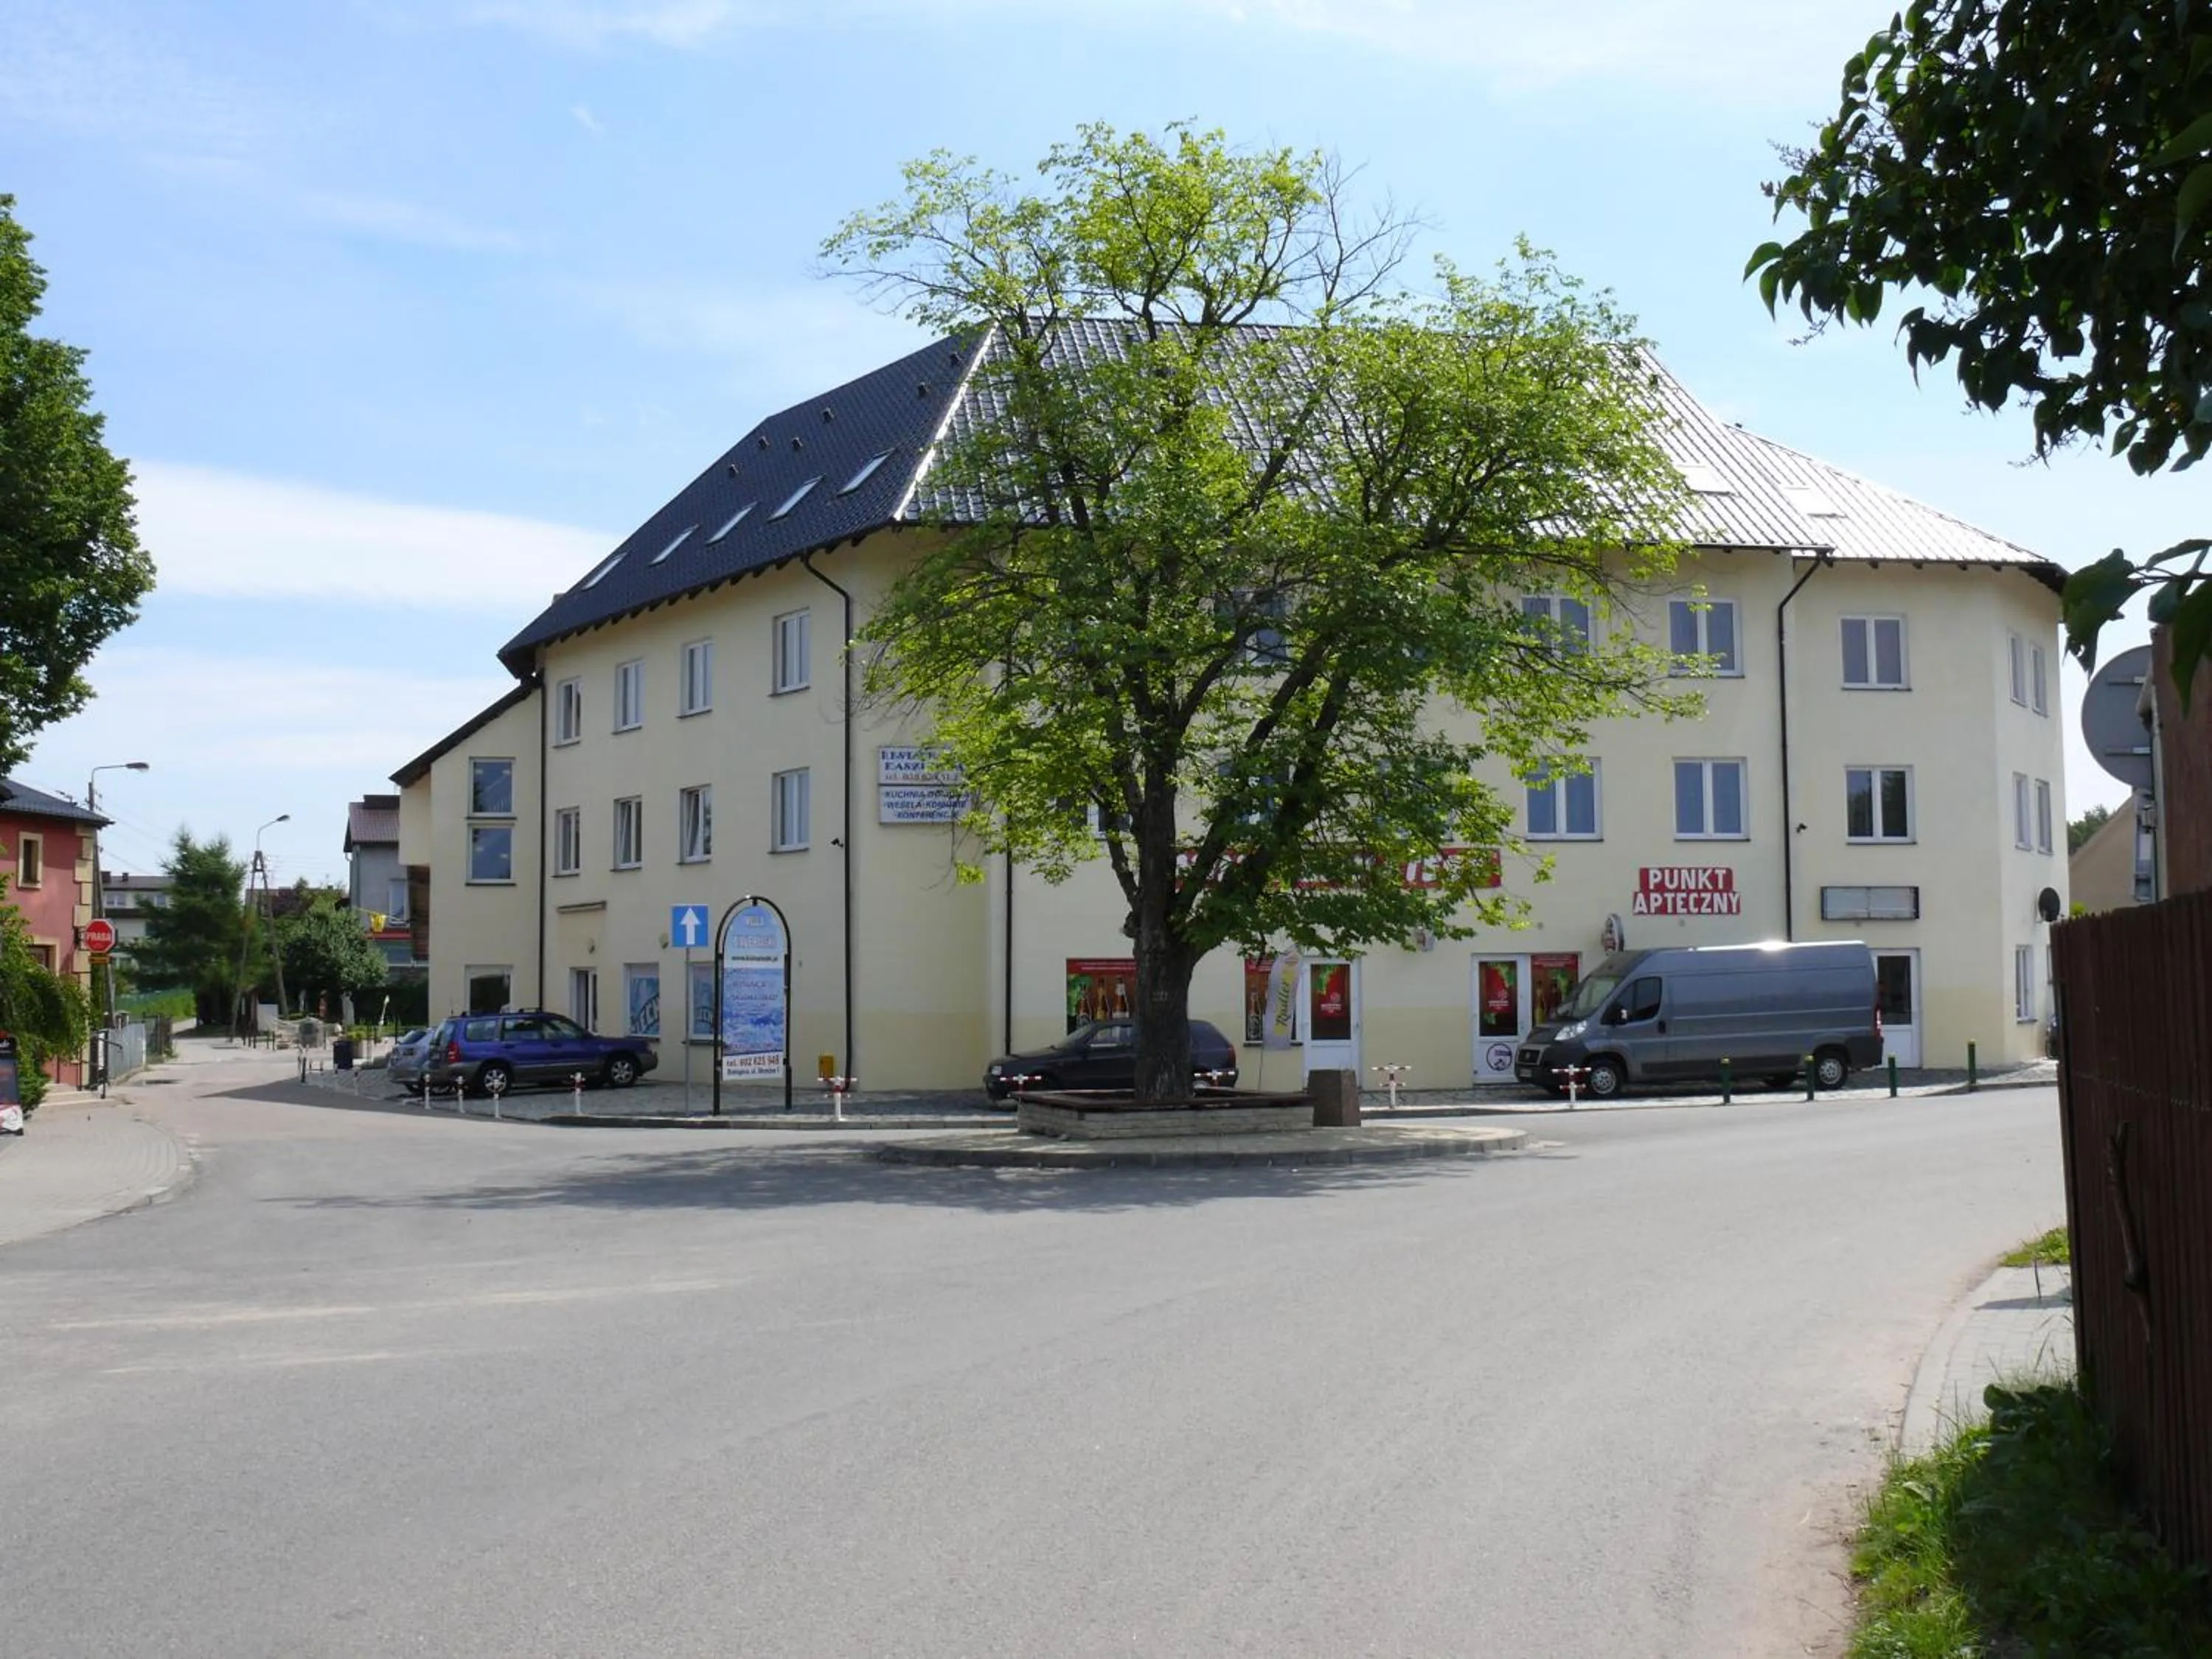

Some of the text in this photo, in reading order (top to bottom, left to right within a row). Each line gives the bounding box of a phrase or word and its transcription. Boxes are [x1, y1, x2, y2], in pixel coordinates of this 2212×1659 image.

[1648, 869, 1727, 890] PUNKT
[1633, 892, 1741, 914] APTECZNY
[86, 931, 111, 942] PRASA
